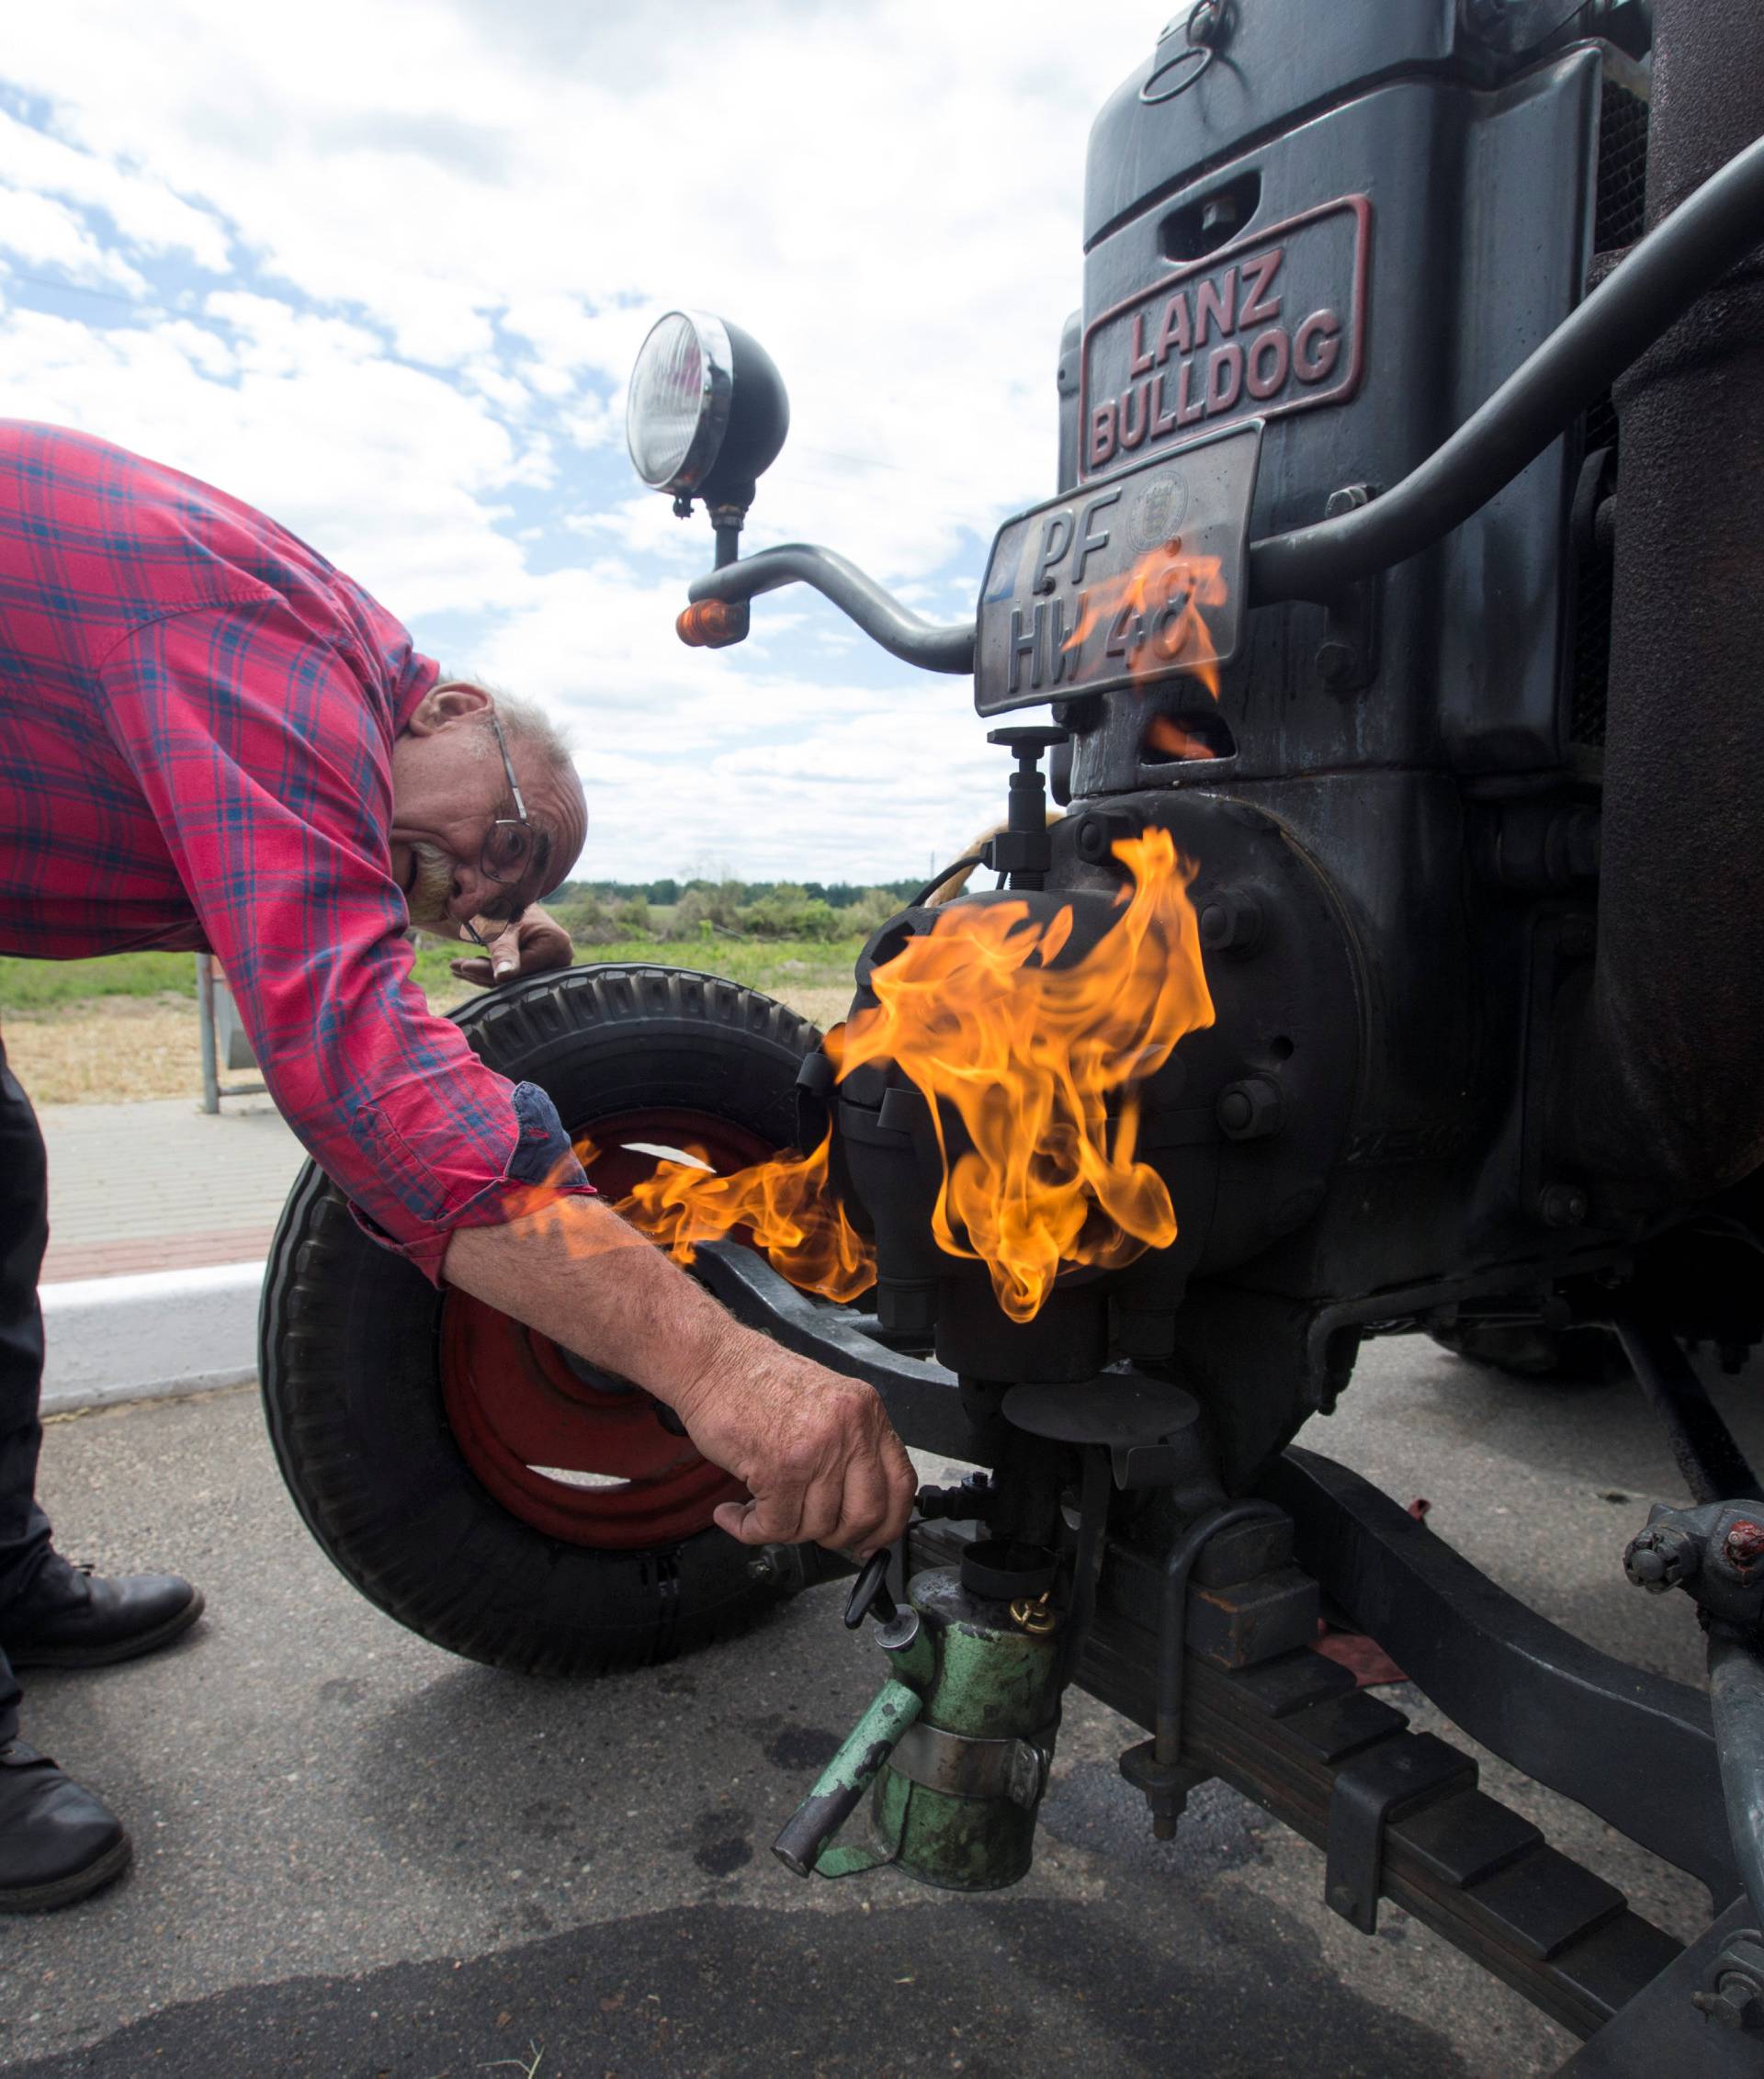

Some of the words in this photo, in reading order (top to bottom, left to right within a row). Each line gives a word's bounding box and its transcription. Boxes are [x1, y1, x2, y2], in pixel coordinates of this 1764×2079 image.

[1130, 247, 1283, 379] LANZ
[1091, 308, 1340, 469] BULLDOG
[1033, 486, 1123, 596] PF
